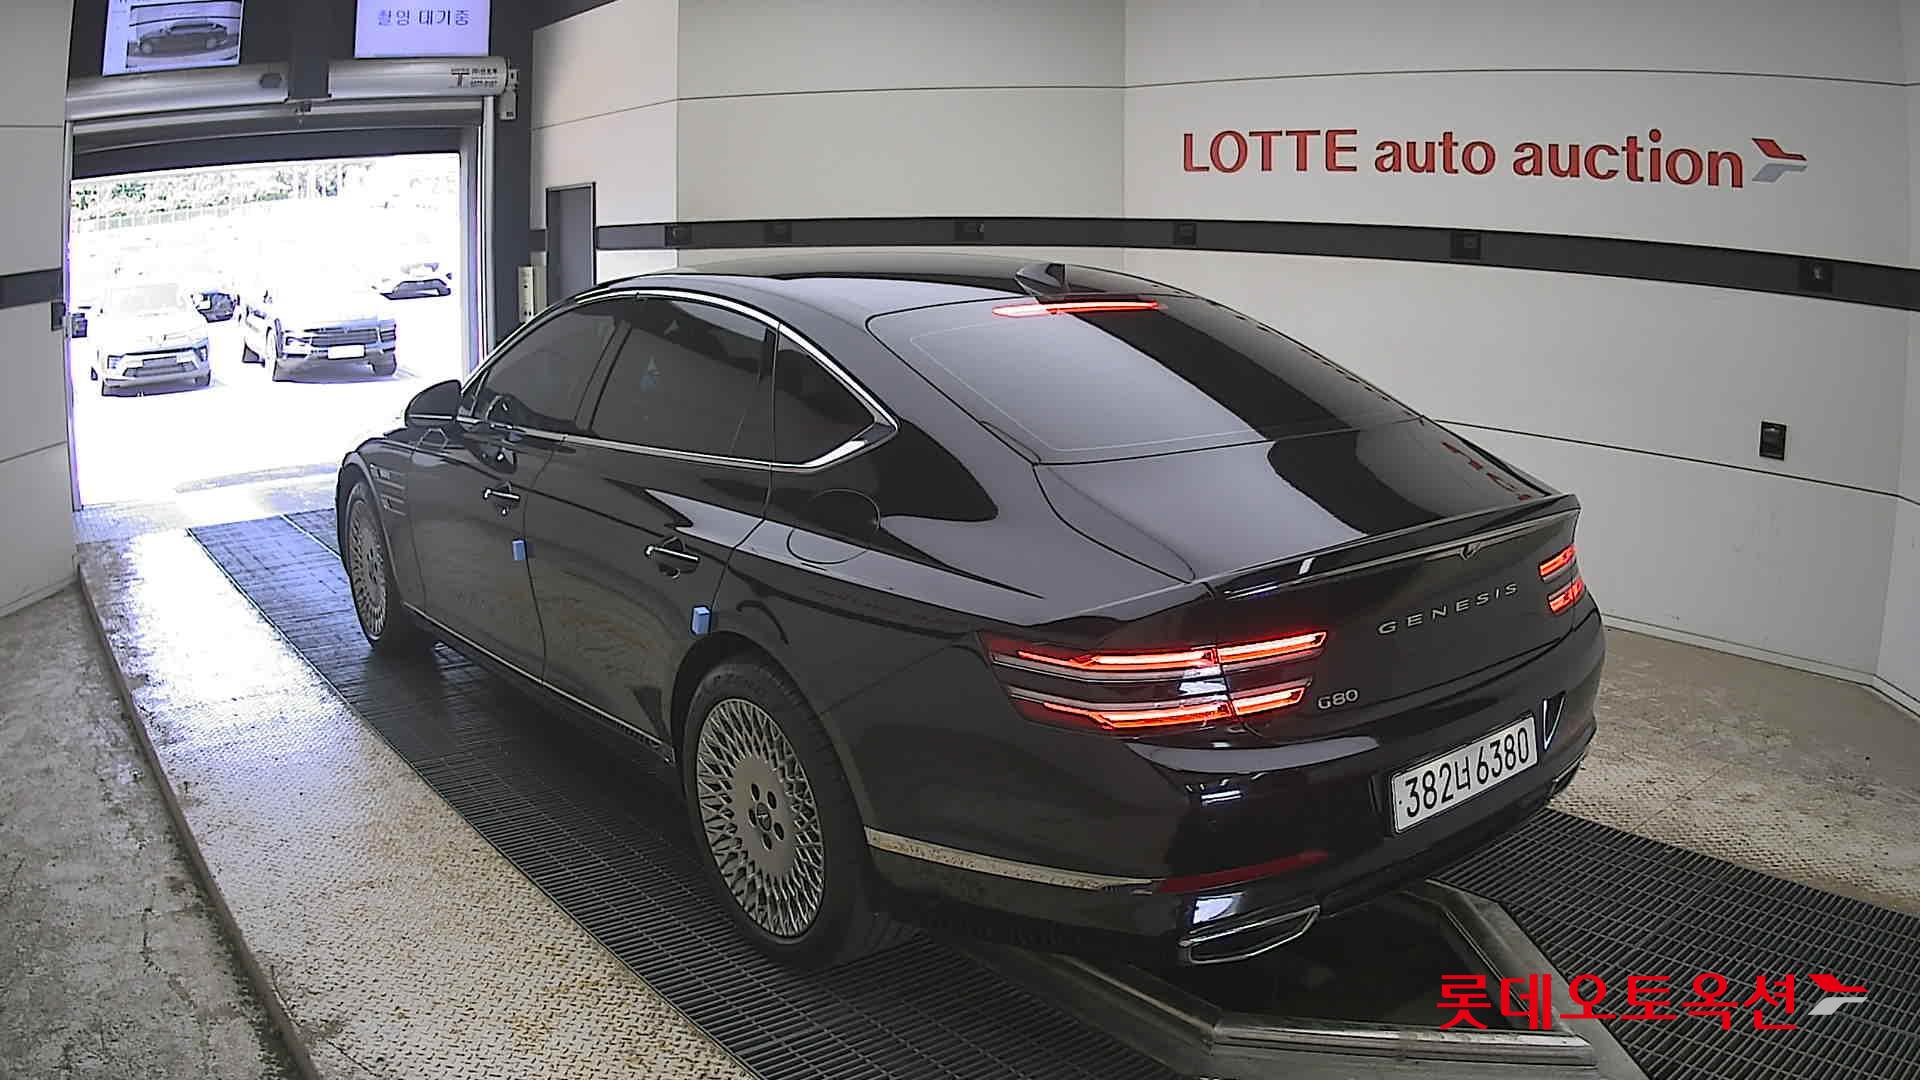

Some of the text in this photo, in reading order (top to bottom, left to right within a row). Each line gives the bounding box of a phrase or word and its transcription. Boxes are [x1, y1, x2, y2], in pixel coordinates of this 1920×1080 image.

[419, 9, 469, 26] 대기중
[1184, 129, 1744, 189] LOTTE auto auction
[1377, 582, 1519, 634] GENESIS
[1317, 688, 1360, 710] G80
